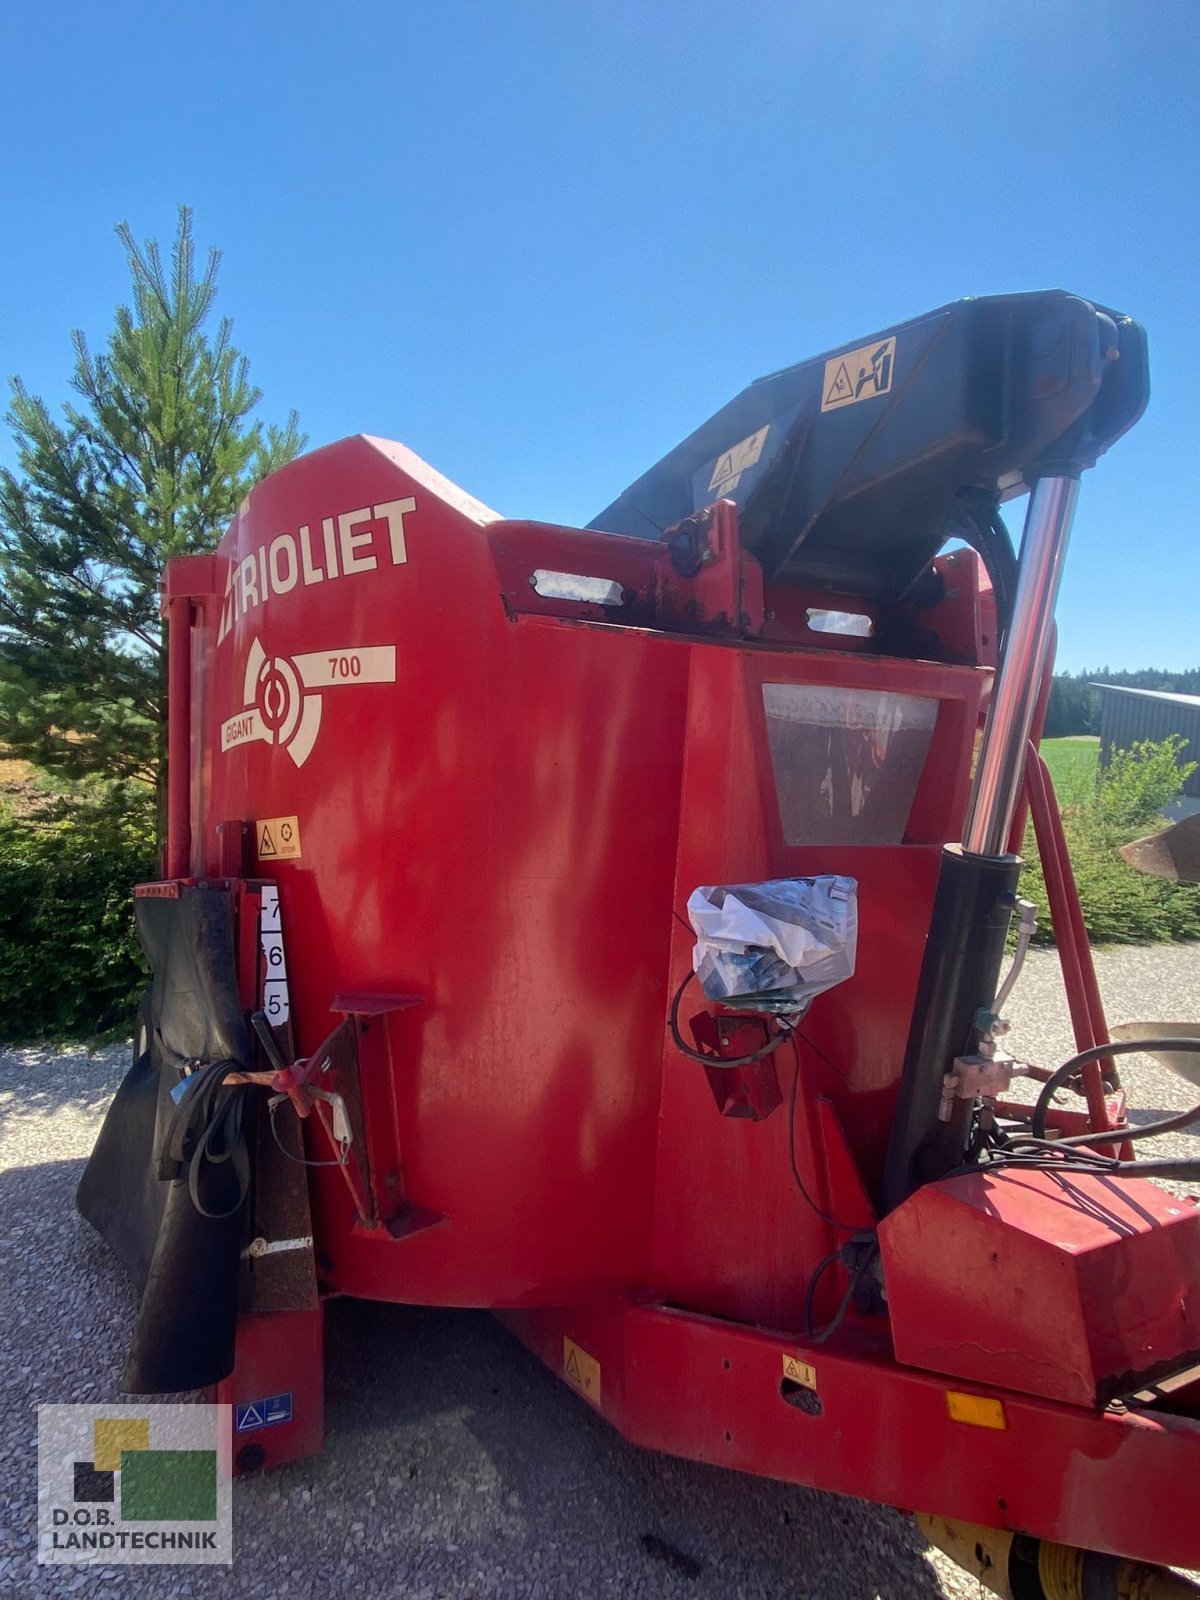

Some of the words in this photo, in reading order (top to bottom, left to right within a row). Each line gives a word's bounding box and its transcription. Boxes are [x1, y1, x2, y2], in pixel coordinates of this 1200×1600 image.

[232, 496, 417, 622] TRIOLIET
[328, 655, 361, 678] 700
[225, 716, 254, 744] GIGANT
[270, 898, 280, 918] 7
[269, 946, 282, 966] 6
[268, 994, 281, 1015] 5
